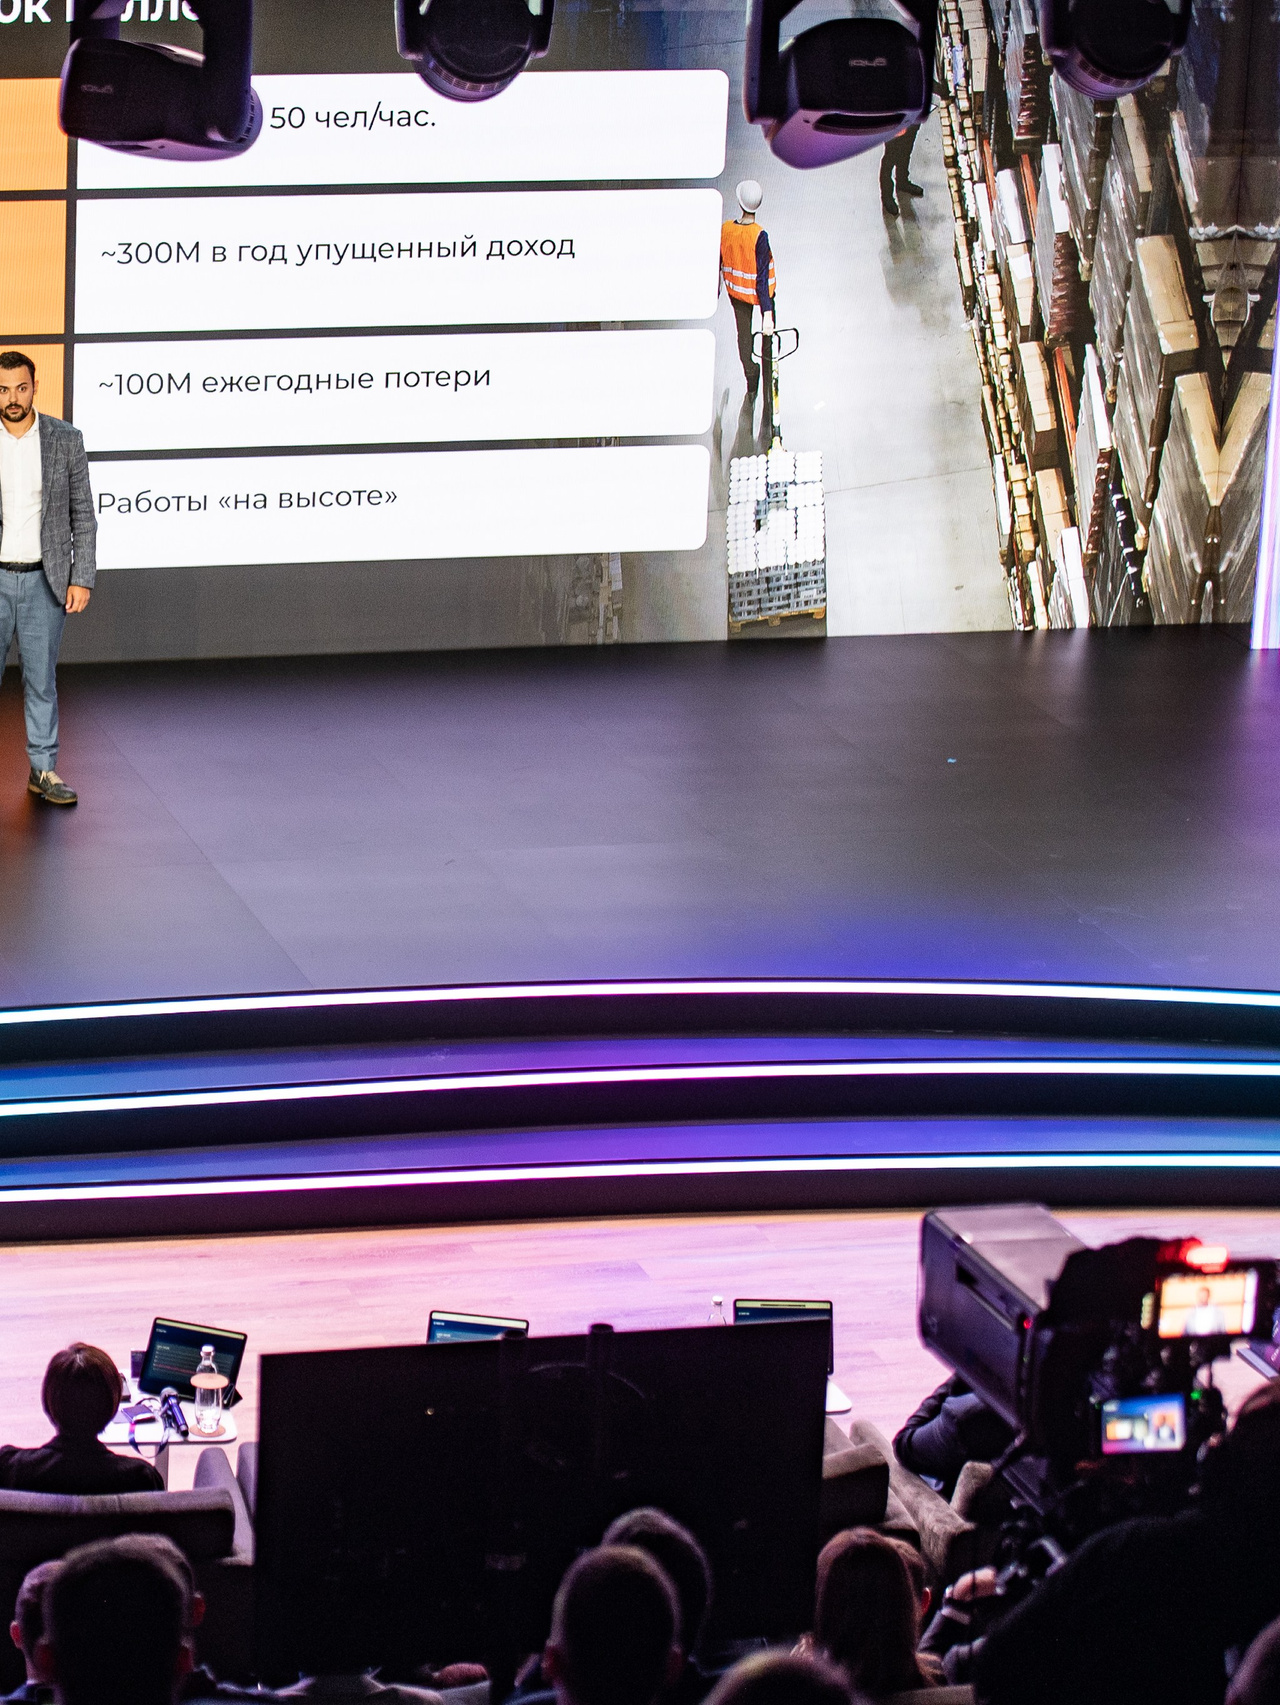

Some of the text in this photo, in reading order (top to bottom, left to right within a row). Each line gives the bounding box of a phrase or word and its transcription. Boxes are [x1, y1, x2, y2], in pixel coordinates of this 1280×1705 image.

[269, 101, 437, 131] 50 чел/час.
[212, 245, 227, 263] в
[238, 244, 288, 265] год
[295, 234, 477, 267] упущенный
[486, 237, 576, 261] доход
[202, 370, 375, 396] ежегодные
[385, 367, 492, 393] потери
[97, 489, 398, 514] Работы «на высоте»
